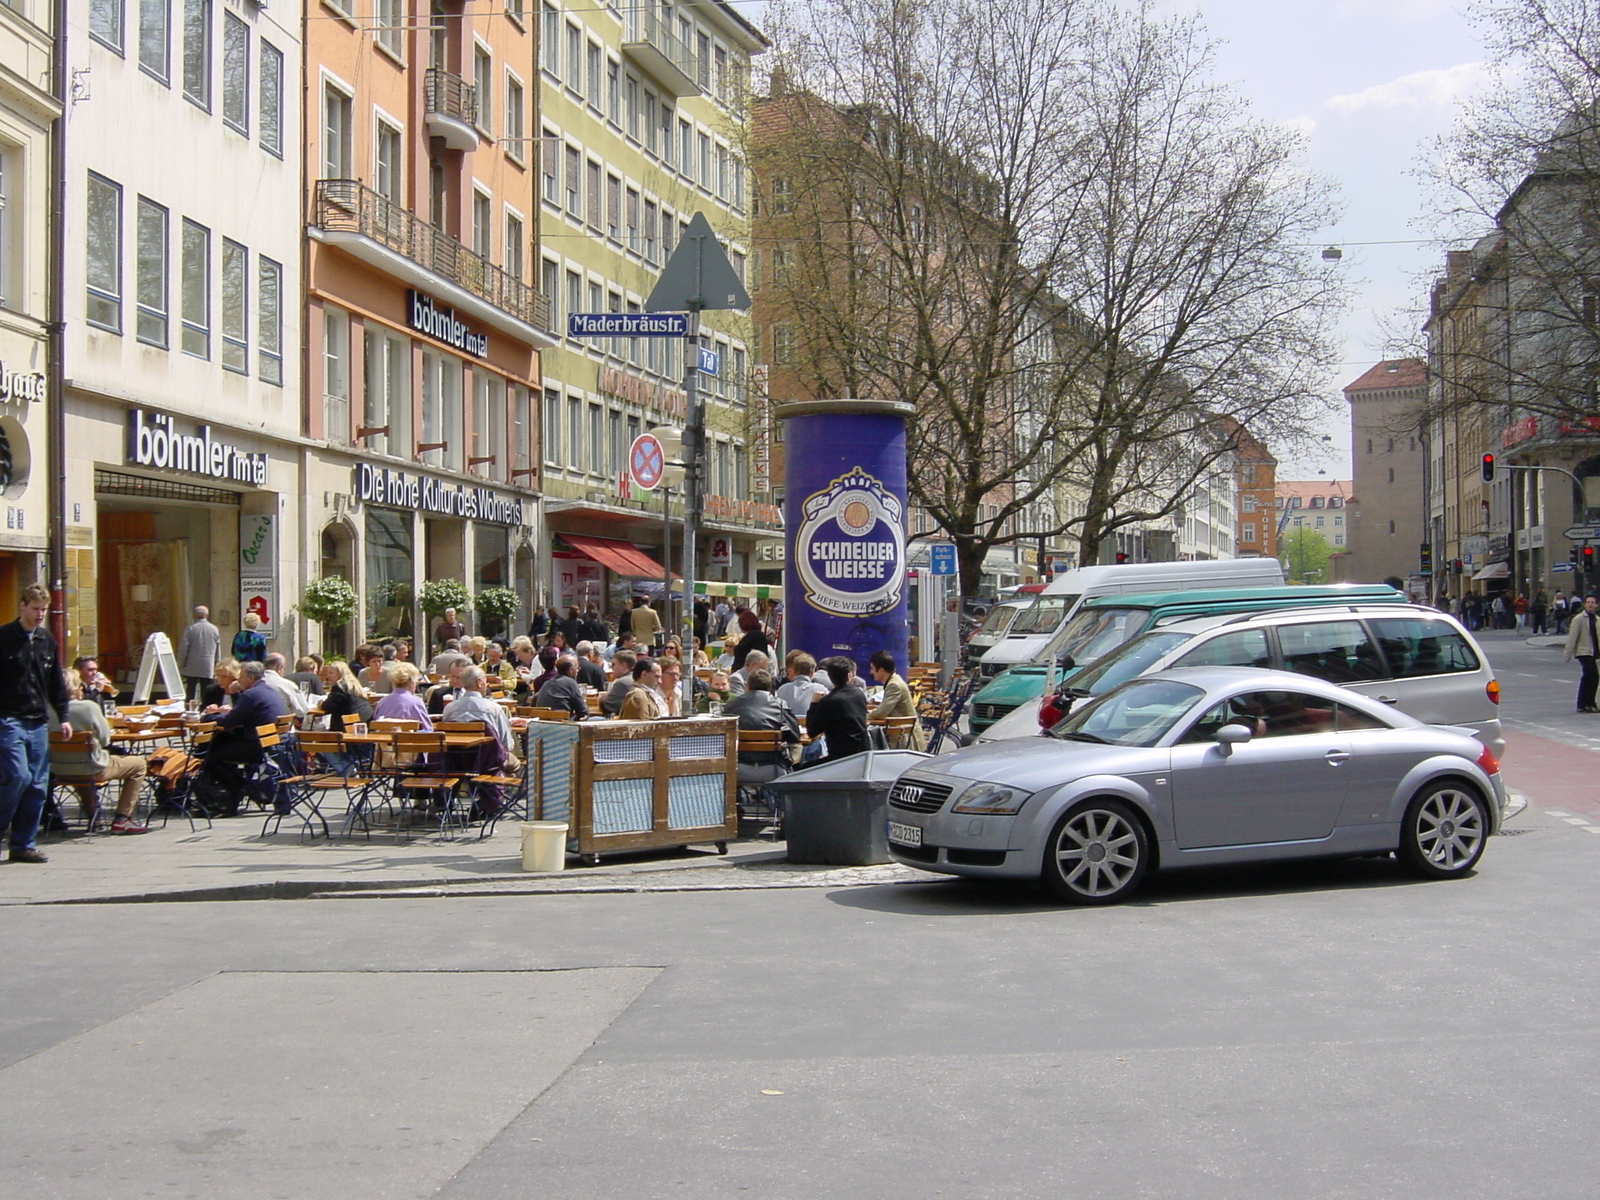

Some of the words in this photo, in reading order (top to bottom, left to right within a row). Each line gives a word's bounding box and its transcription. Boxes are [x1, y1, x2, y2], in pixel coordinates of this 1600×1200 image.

[414, 290, 466, 348] böhmler
[466, 327, 477, 354] im
[478, 333, 488, 359] tal
[574, 315, 684, 333] Maderbräustr.
[702, 351, 714, 371] Tal
[755, 368, 766, 491] APOTHEKE
[137, 409, 232, 478] böhmler
[233, 446, 251, 481] im
[252, 453, 269, 484] tal
[361, 463, 384, 503] Die
[387, 469, 419, 509] hohe
[423, 476, 455, 514] Kultur
[457, 484, 477, 518] des
[812, 542, 894, 560] SCHNEIDER
[825, 561, 885, 578] WEISSE
[904, 827, 920, 843] 2315
